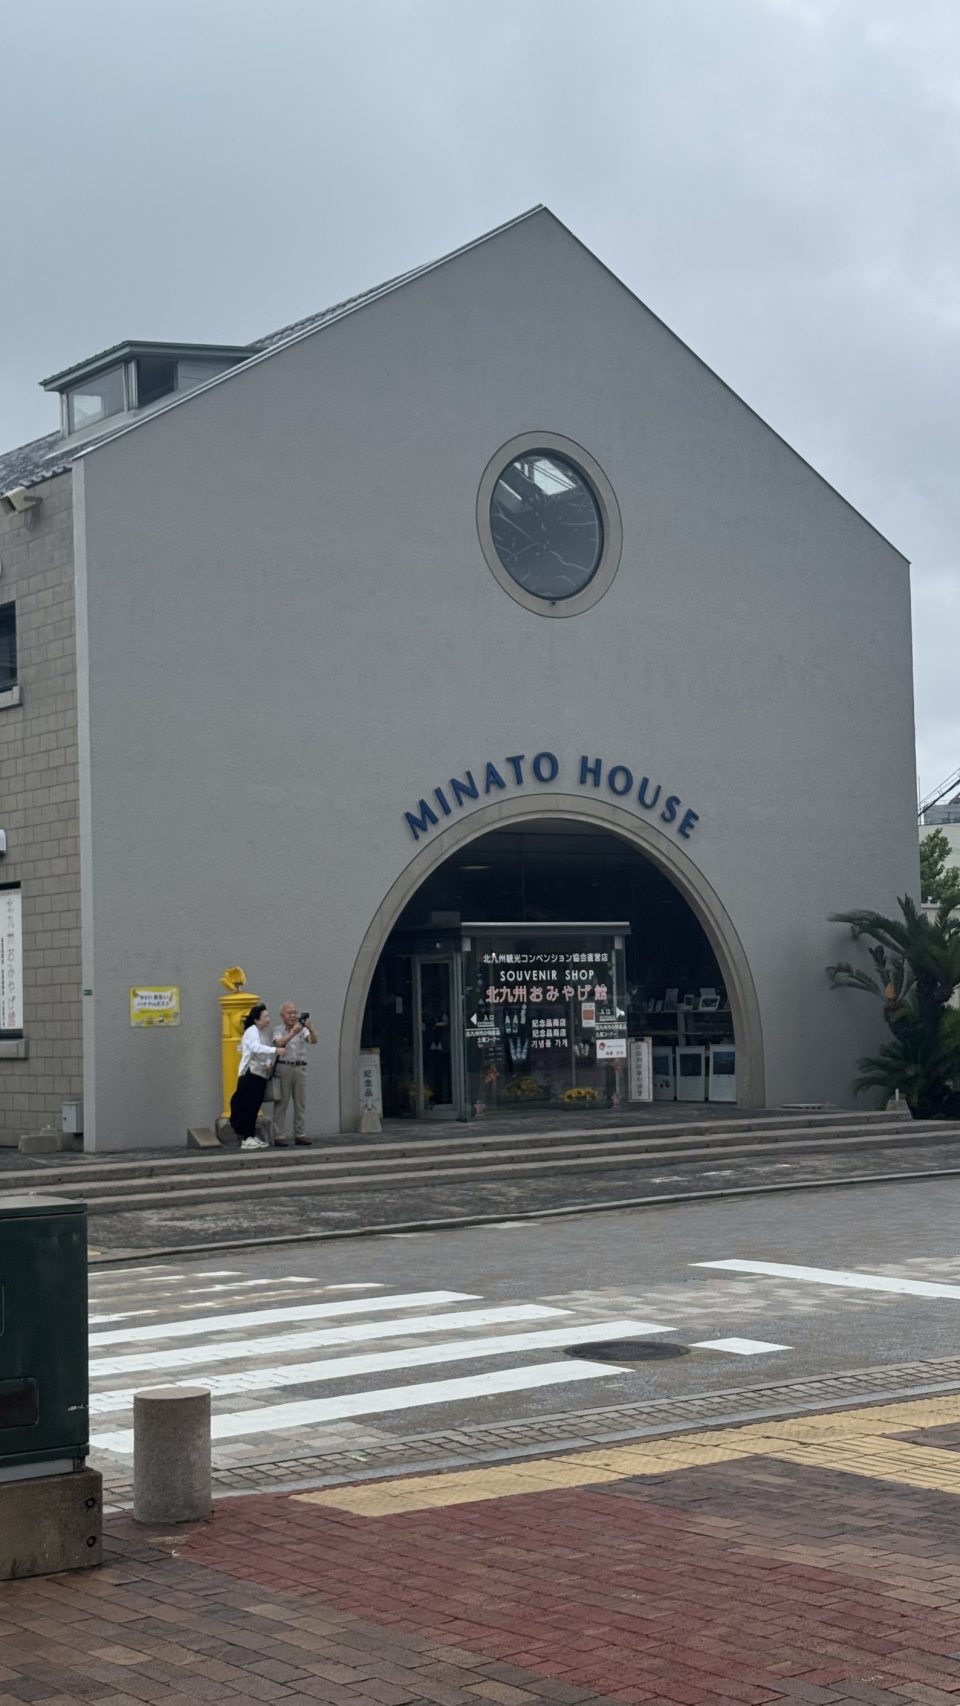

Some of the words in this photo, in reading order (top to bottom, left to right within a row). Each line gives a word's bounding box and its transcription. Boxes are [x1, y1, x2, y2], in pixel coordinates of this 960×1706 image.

[403, 751, 559, 841] MINATO
[579, 754, 700, 840] HOUSE
[500, 970, 557, 981] SOUVENIR
[565, 969, 595, 980] SHOP
[486, 983, 608, 1003] 北九州おみやげ館
[363, 1069, 374, 1097] 記念品
